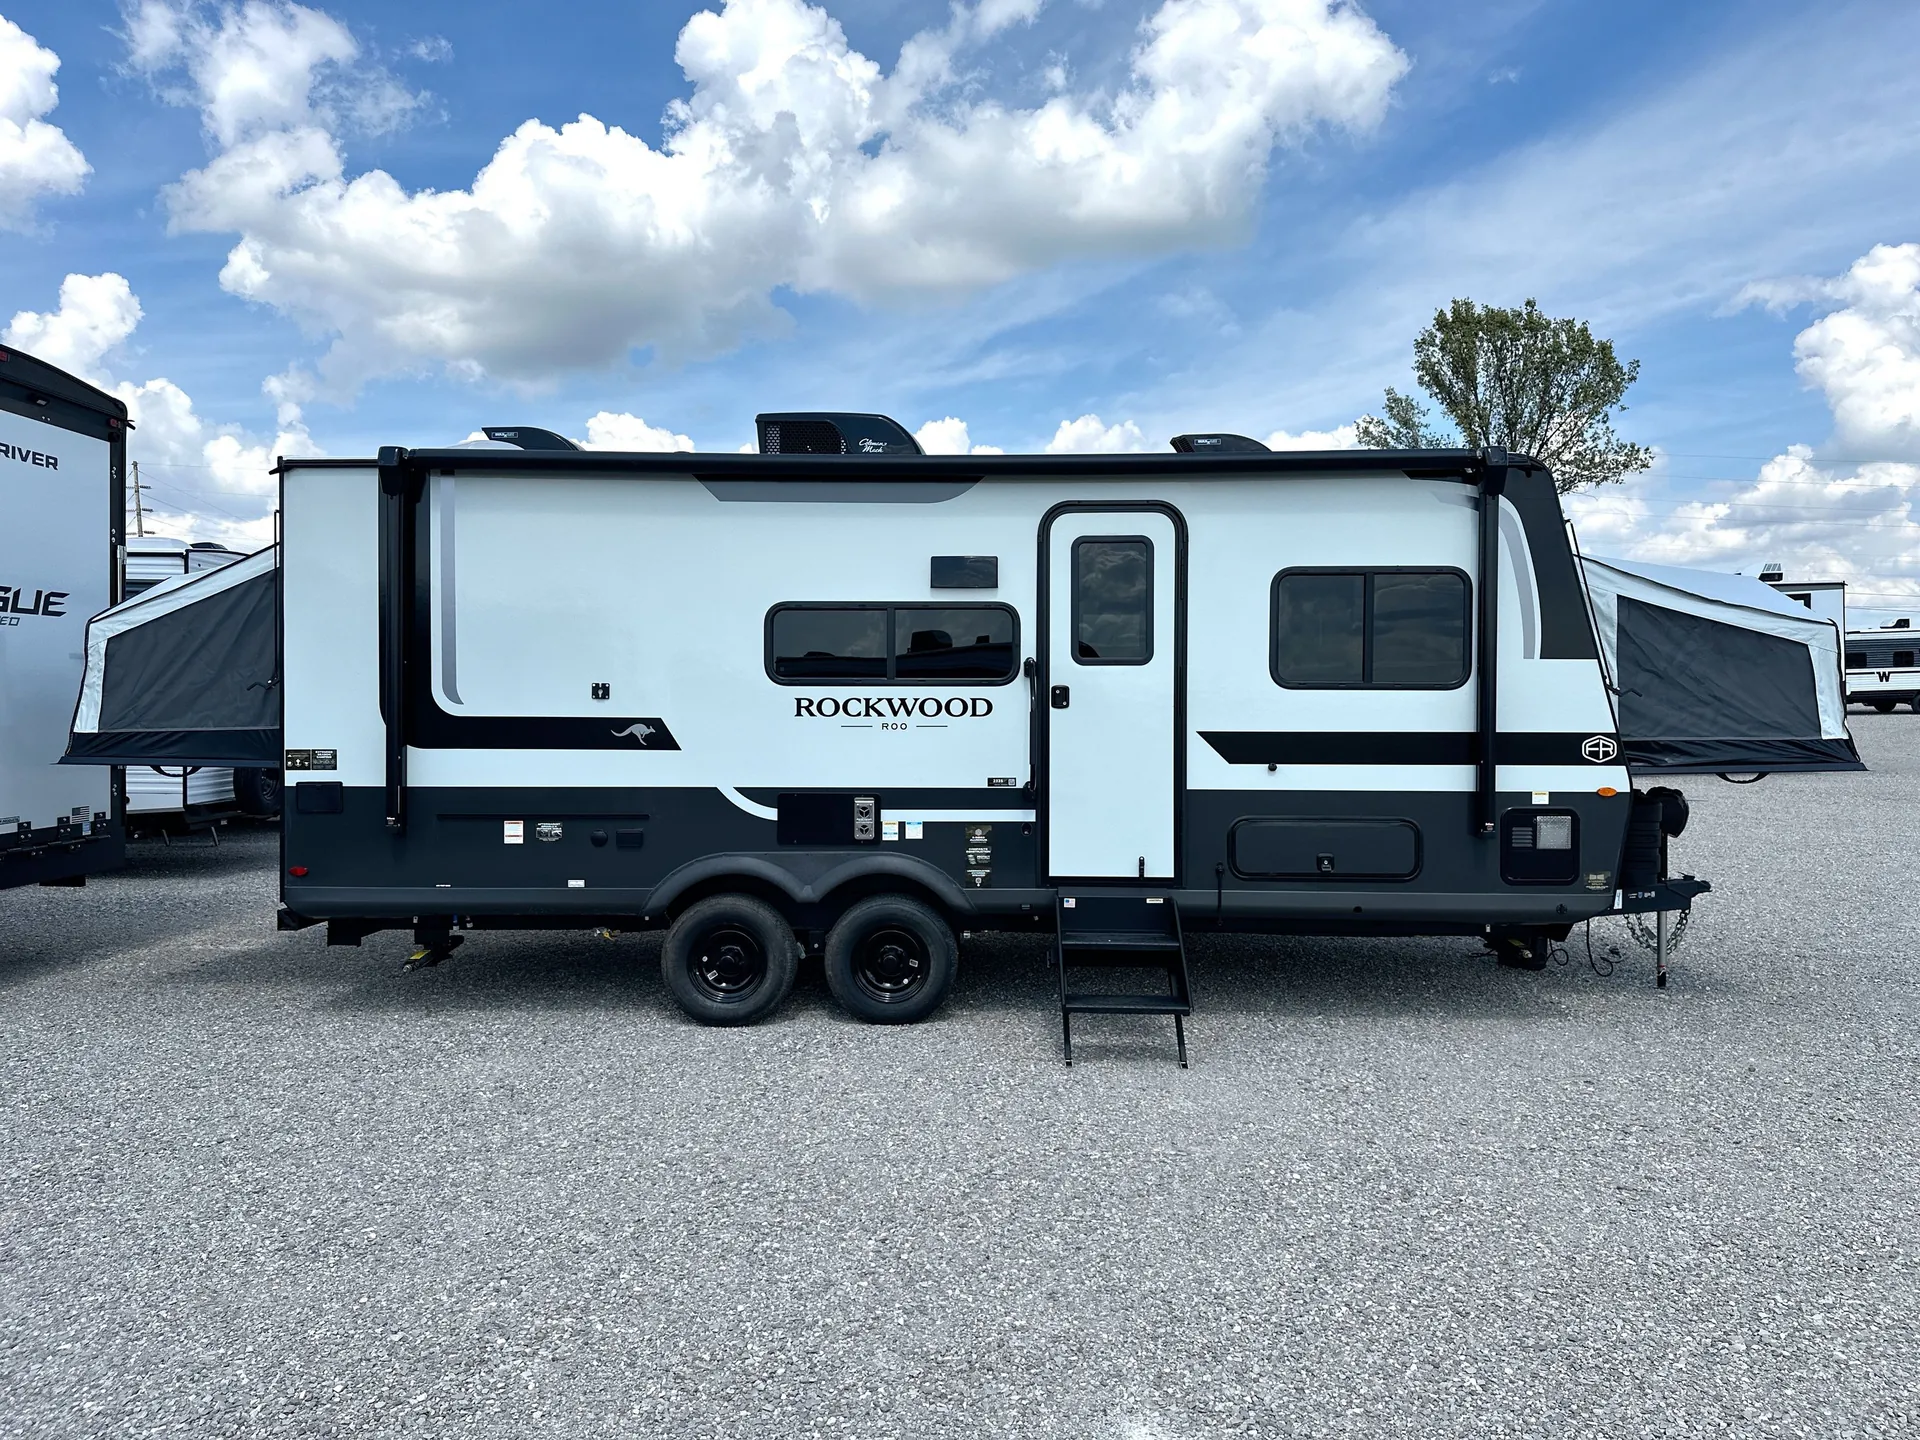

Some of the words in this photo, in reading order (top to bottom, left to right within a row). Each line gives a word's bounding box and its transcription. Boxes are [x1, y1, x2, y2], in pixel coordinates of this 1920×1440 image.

[0, 442, 59, 471] RIVER
[794, 697, 993, 718] ROCKWOOD
[881, 722, 908, 731] ROO
